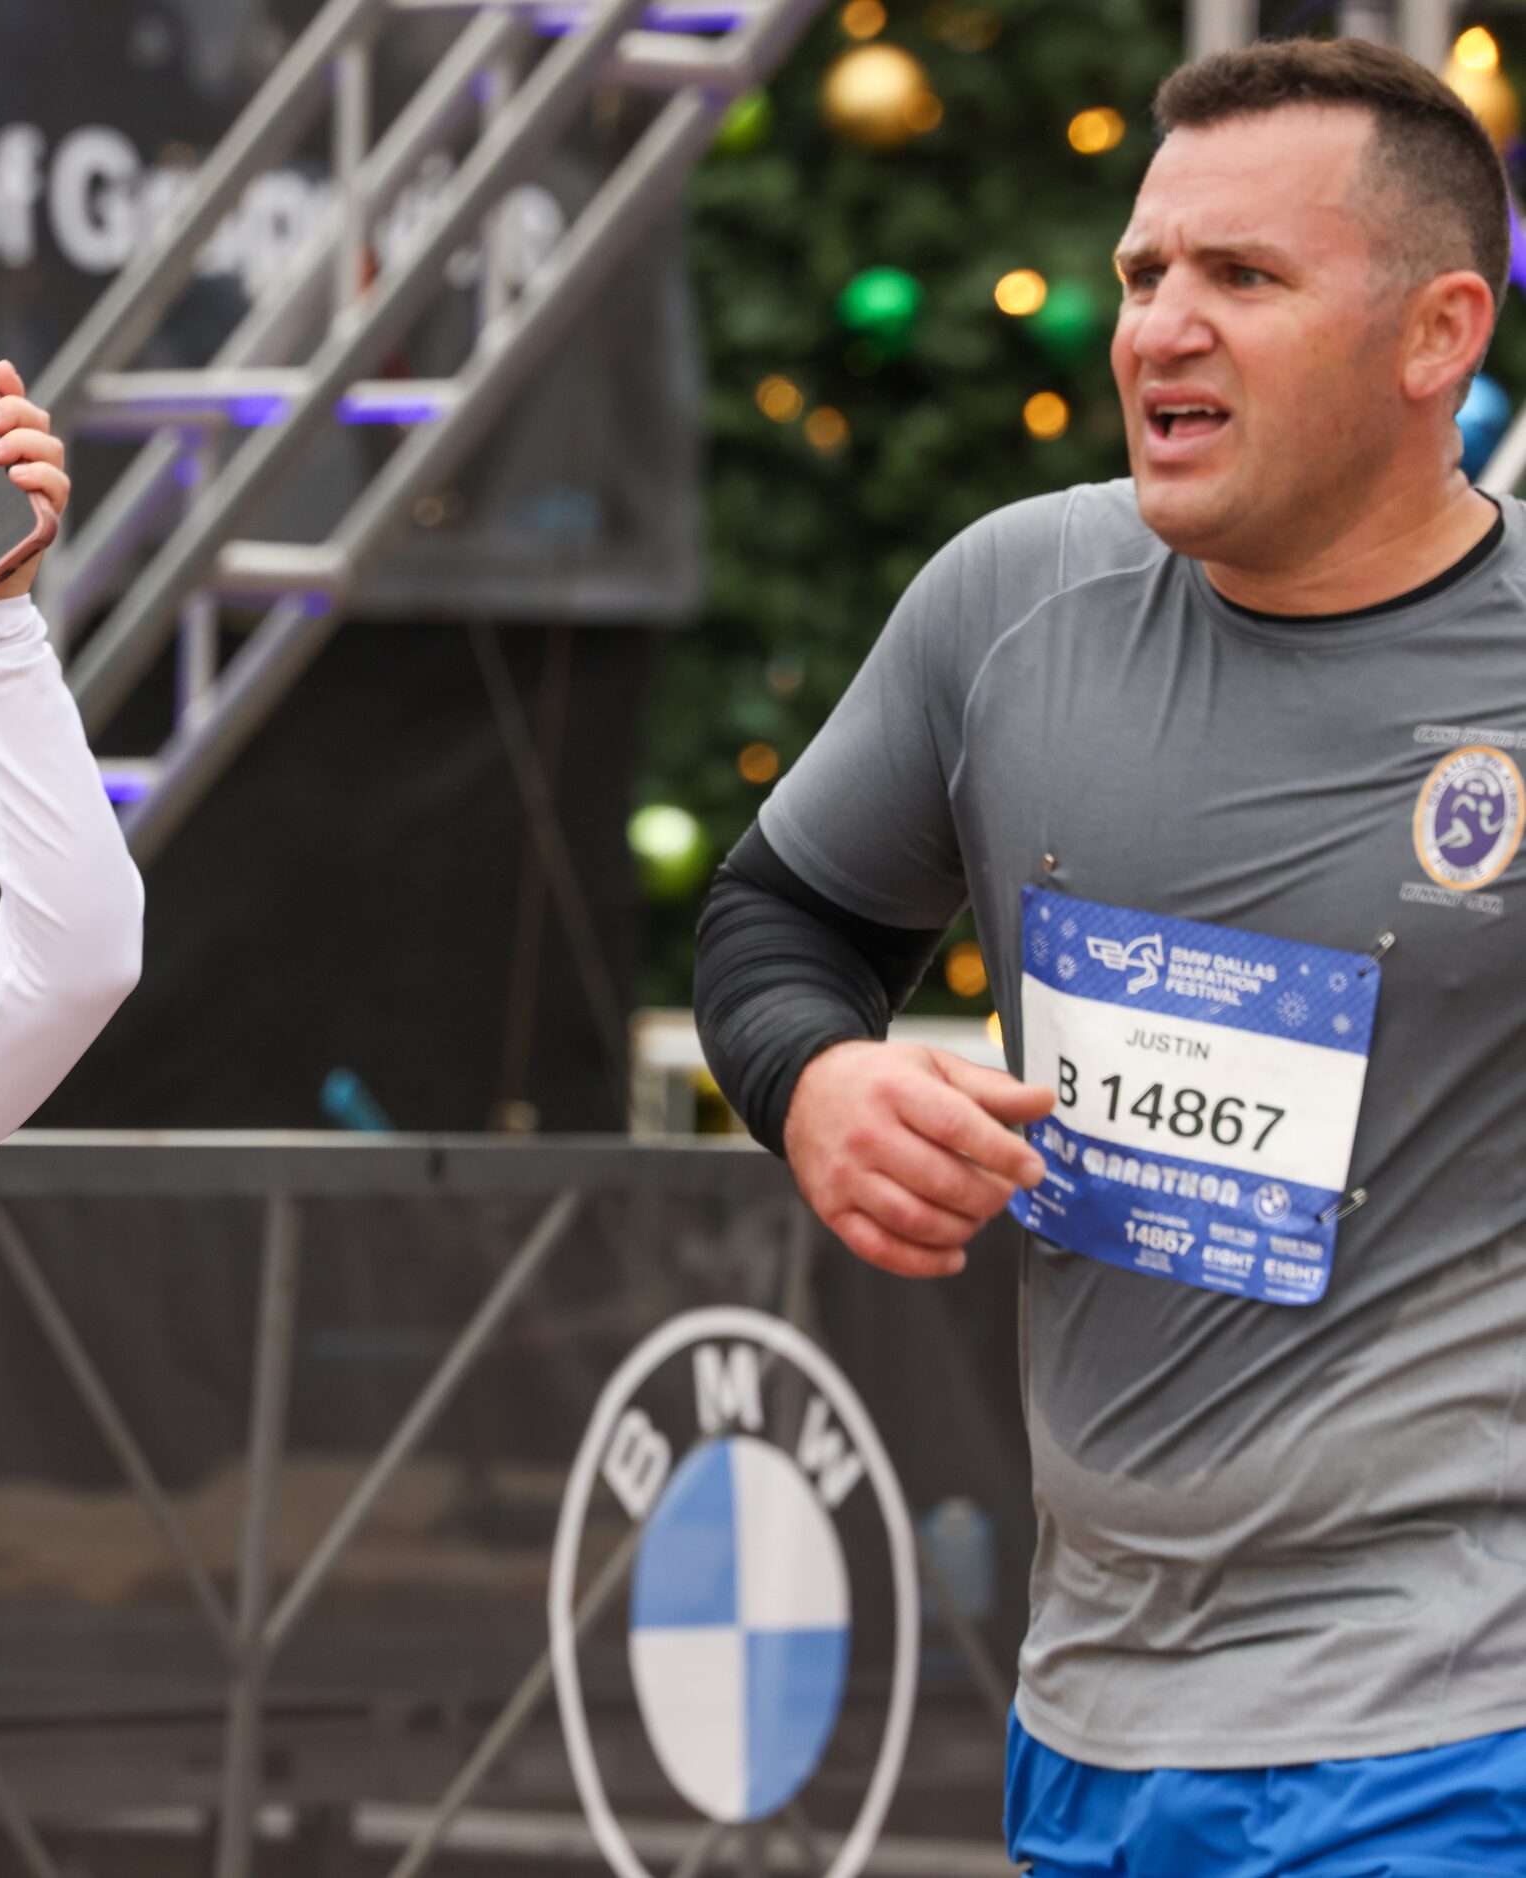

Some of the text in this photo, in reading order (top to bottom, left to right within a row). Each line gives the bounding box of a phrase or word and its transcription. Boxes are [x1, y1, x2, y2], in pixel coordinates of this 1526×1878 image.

[1168, 962, 1261, 994] MARATHON
[1170, 946, 1277, 982] BMW DALLAS
[1165, 977, 1242, 1006] FESTIVAL
[1126, 1027, 1211, 1061] JUSTIN
[1058, 1056, 1287, 1153] B 14867
[1082, 1146, 1240, 1208] MARATHON
[1124, 1219, 1194, 1256] 14867
[602, 1343, 869, 1521] BMW
